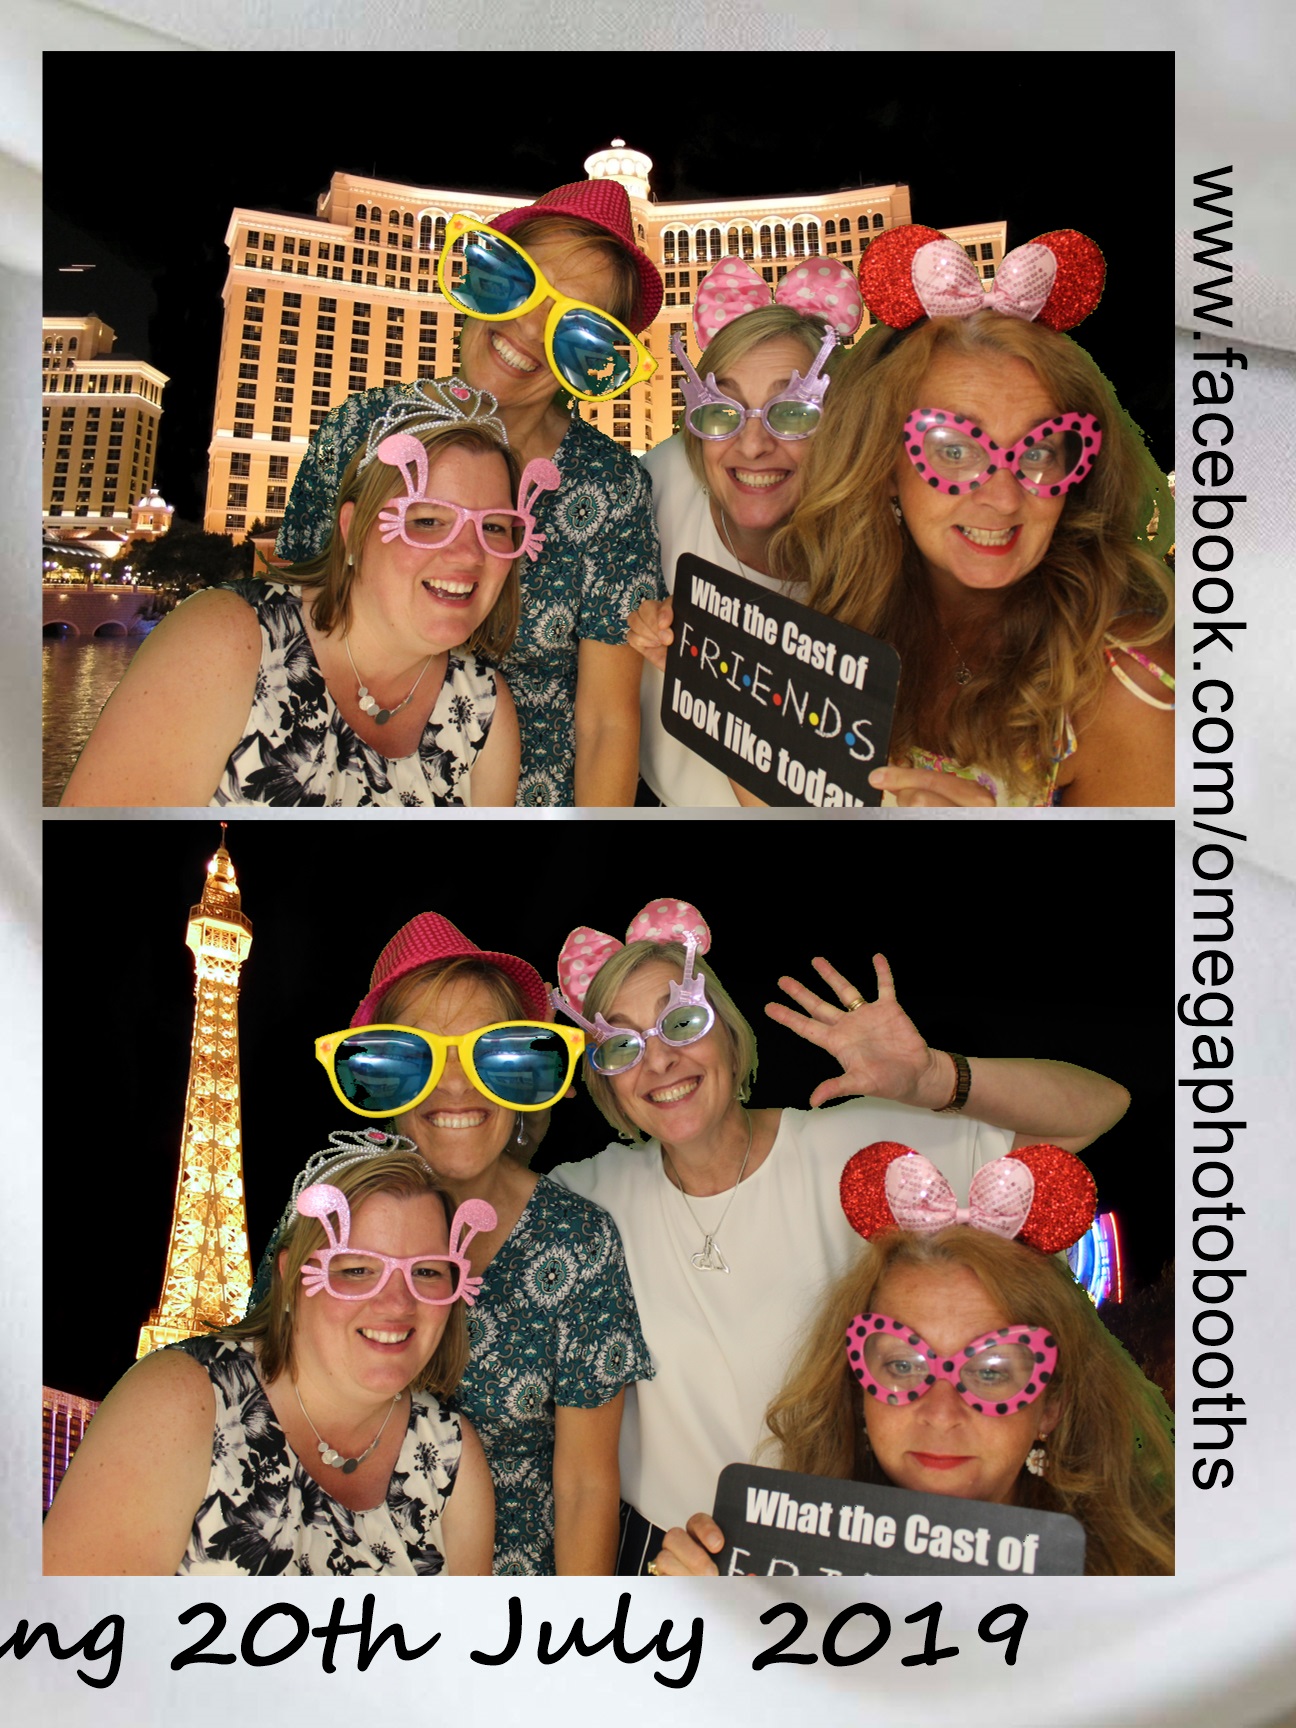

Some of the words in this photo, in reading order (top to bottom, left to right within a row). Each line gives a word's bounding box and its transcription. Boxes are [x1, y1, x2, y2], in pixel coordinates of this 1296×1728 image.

[691, 574, 740, 628] What
[742, 603, 778, 645] the
[781, 621, 837, 677] Cast
[839, 652, 869, 691] of
[671, 678, 722, 741] look
[723, 711, 773, 774] like
[745, 1486, 833, 1538] What
[838, 1504, 897, 1549] the
[904, 1514, 991, 1567] Cast
[997, 1533, 1039, 1575] of
